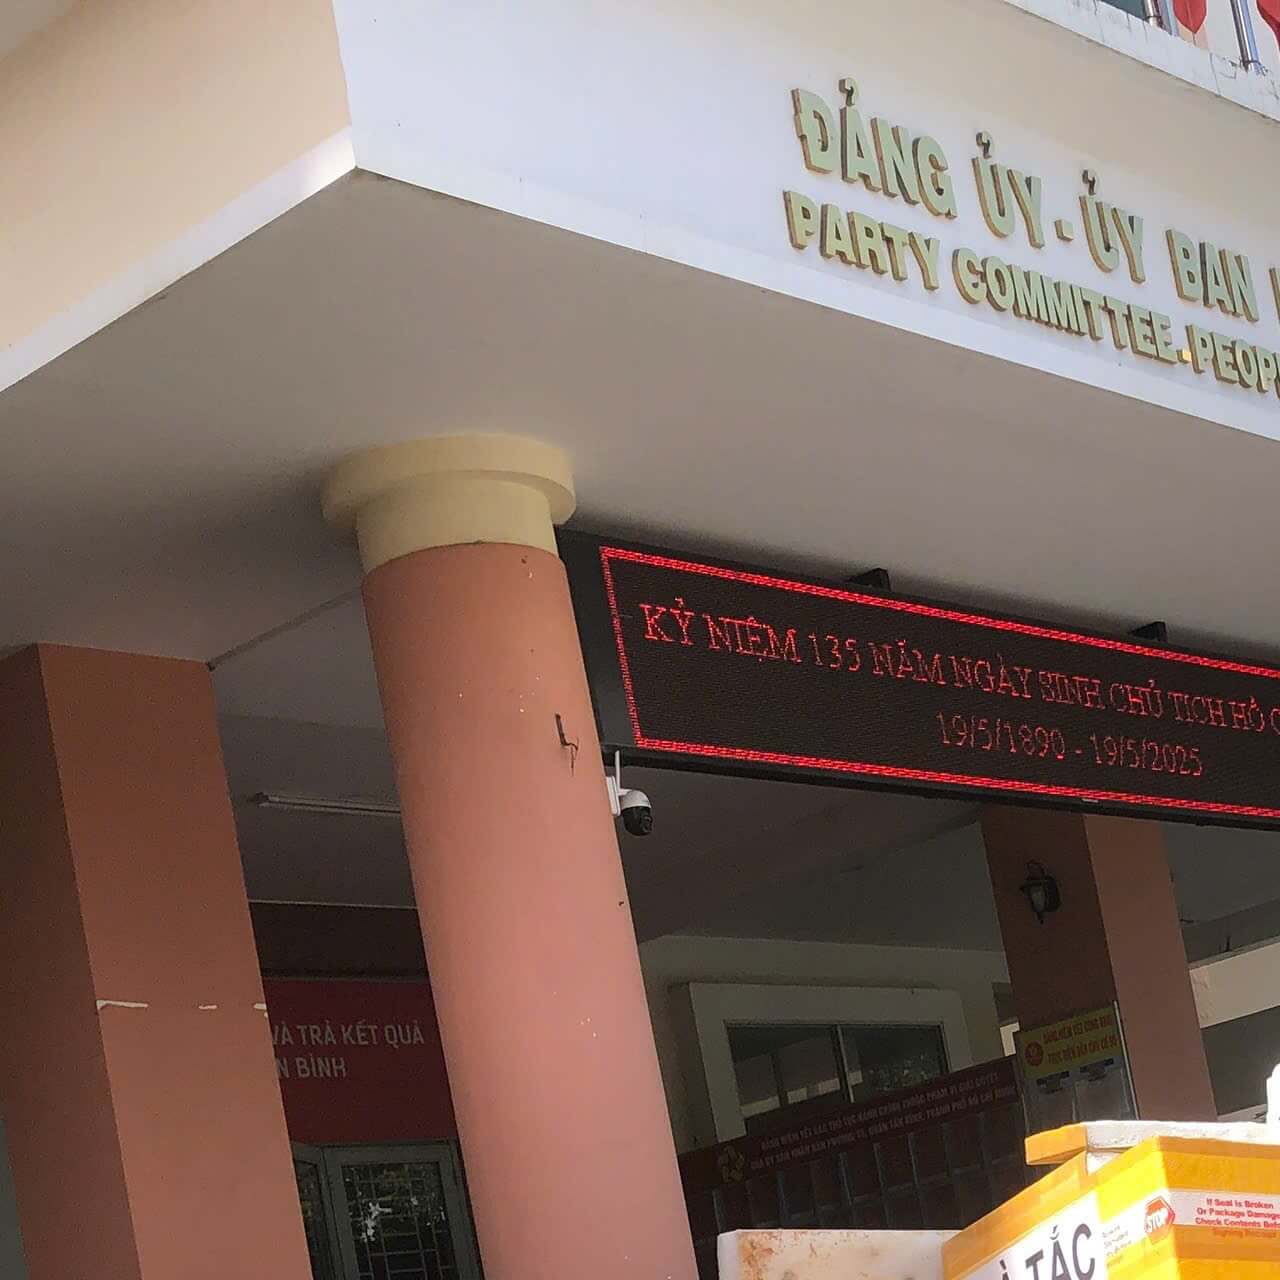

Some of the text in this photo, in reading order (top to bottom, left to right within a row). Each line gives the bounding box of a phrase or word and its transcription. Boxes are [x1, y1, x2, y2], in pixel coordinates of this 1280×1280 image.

[791, 77, 957, 219] ĐẢNG
[971, 130, 1045, 249] ỦY
[1079, 168, 1146, 284] ỦY
[1165, 228, 1260, 323] BAN
[783, 190, 940, 291] PARTY
[808, 631, 861, 671] 135
[1039, 670, 1105, 710] SINH
[1088, 728, 1204, 776] 19/5/2025
[295, 1054, 348, 1079] BÌNH
[1197, 1207, 1206, 1215] Or
[1209, 1208, 1245, 1218] Package
[1244, 1200, 1274, 1209] Broken
